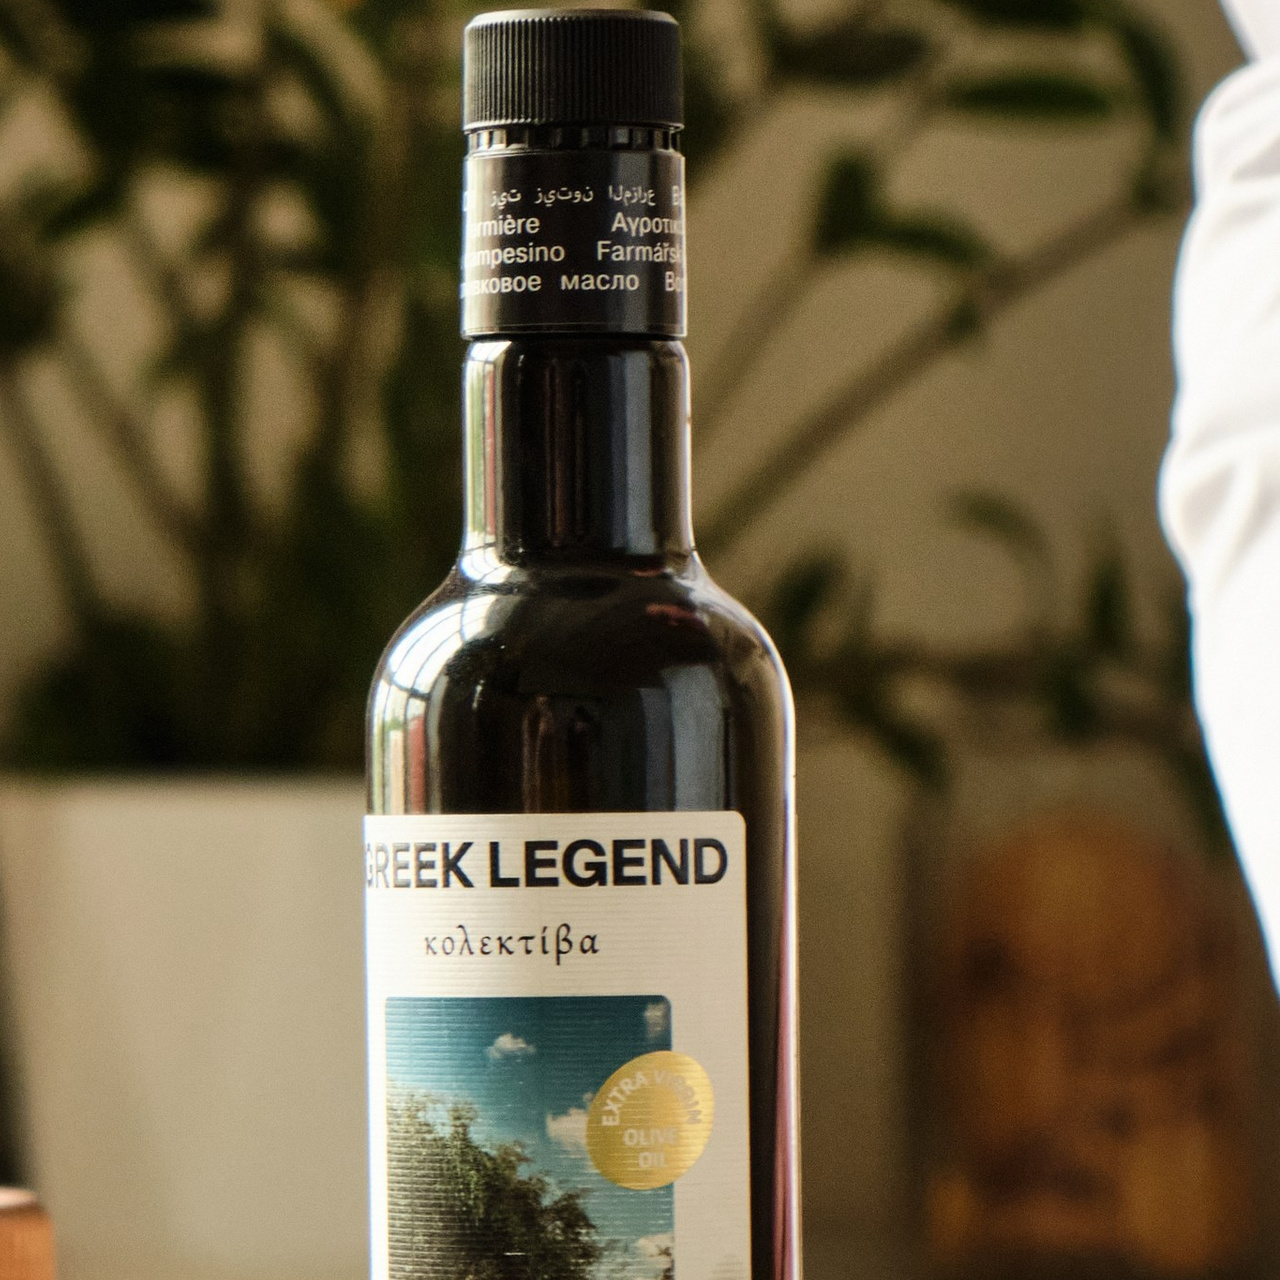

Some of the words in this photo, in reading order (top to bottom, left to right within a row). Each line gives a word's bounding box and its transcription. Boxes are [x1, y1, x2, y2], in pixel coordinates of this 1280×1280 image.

[561, 274, 640, 291] масло
[365, 841, 475, 888] GREEK
[489, 838, 728, 888] LEGEND
[424, 924, 600, 965] κολεκτίβα
[602, 1071, 649, 1126] EXTRA
[624, 1127, 677, 1146] OLIVE
[638, 1151, 669, 1168] OIL
